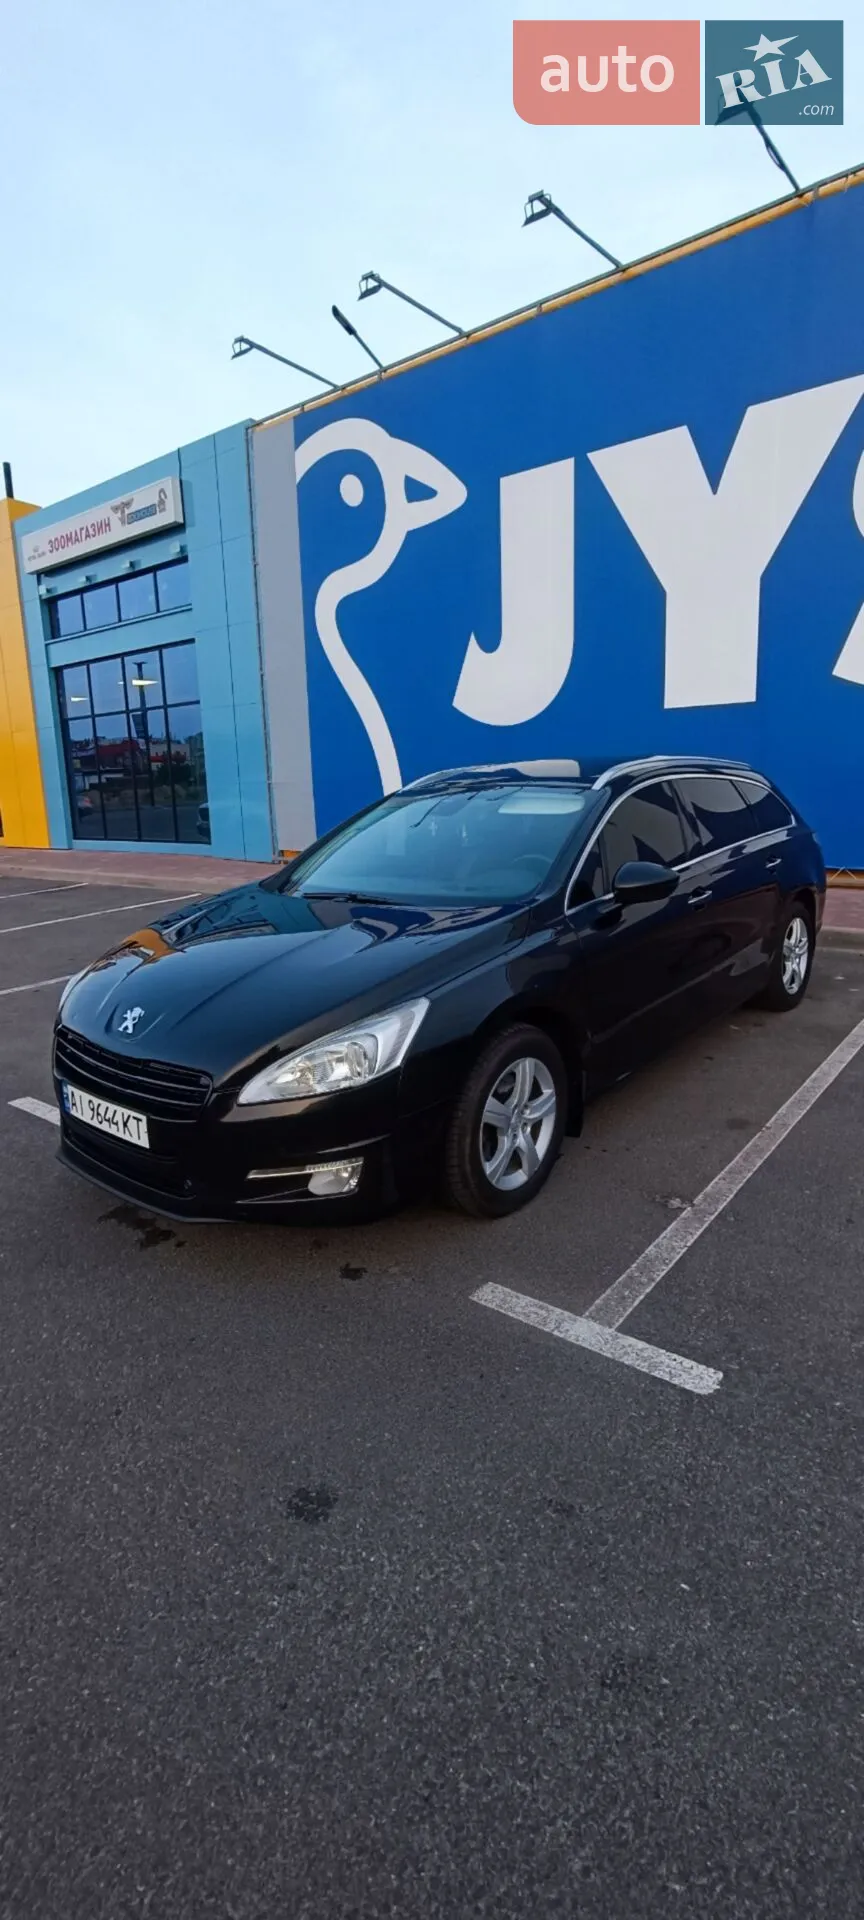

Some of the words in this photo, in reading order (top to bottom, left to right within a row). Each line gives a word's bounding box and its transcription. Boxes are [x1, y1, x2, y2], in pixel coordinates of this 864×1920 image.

[47, 517, 112, 554] ЗООМАГАЗИН
[452, 373, 864, 727] JY
[70, 1090, 84, 1118] AI
